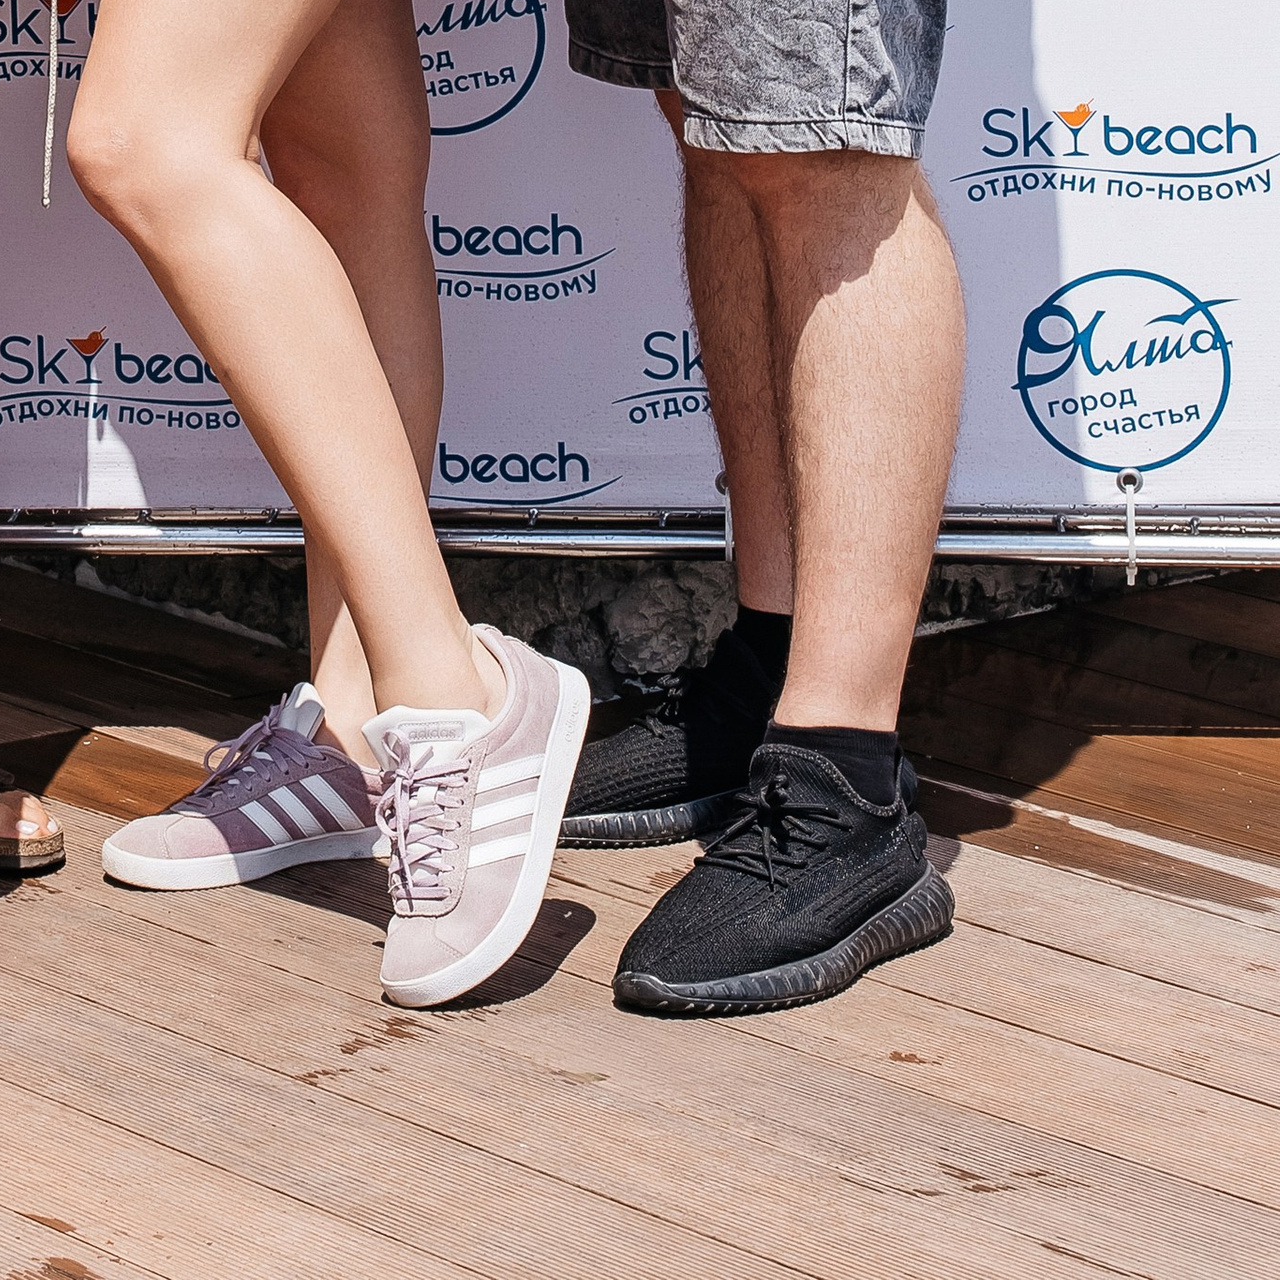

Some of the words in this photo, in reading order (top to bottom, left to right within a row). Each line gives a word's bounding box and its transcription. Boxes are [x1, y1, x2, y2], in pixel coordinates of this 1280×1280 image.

[424, 64, 517, 98] частья
[1103, 112, 1257, 156] beach
[431, 212, 583, 257] beach
[117, 405, 241, 431] по-ново
[1047, 388, 1138, 424] город
[1087, 404, 1201, 439] счастья
[438, 441, 591, 486] beach
[407, 726, 457, 740] adidas
